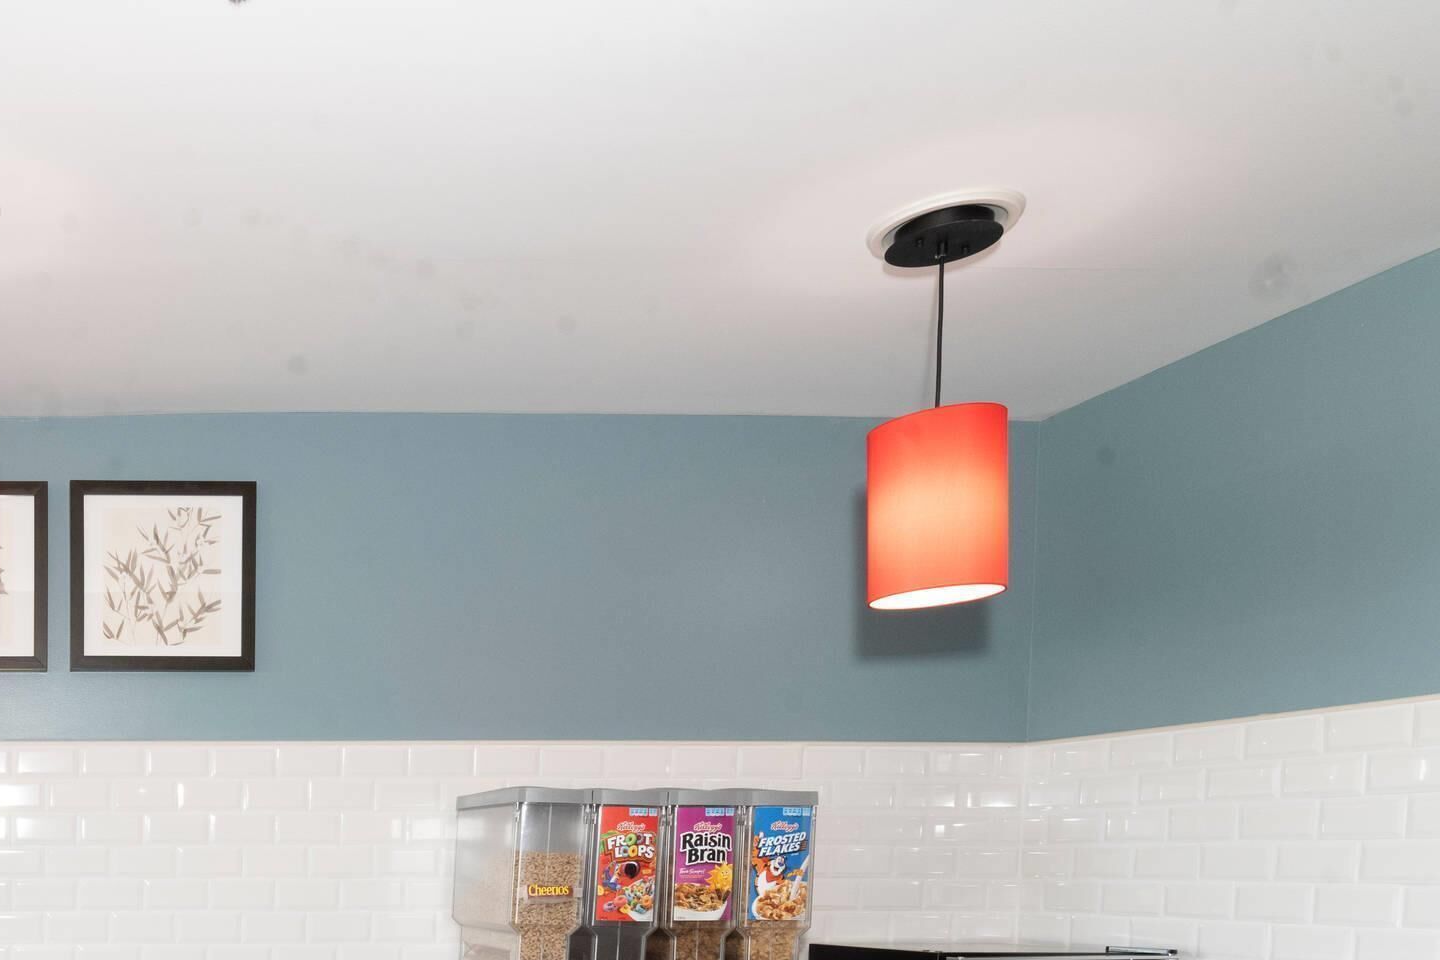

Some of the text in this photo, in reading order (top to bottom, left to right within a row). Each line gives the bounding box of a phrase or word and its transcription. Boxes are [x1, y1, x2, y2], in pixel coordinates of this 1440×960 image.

[607, 832, 653, 850] FROOT
[681, 832, 731, 851] Raisin
[758, 832, 807, 849] FROSTED
[614, 844, 655, 858] LOOPS
[687, 847, 726, 864] Bran
[759, 842, 801, 857] FLAKES
[528, 884, 570, 896] Cheerios
